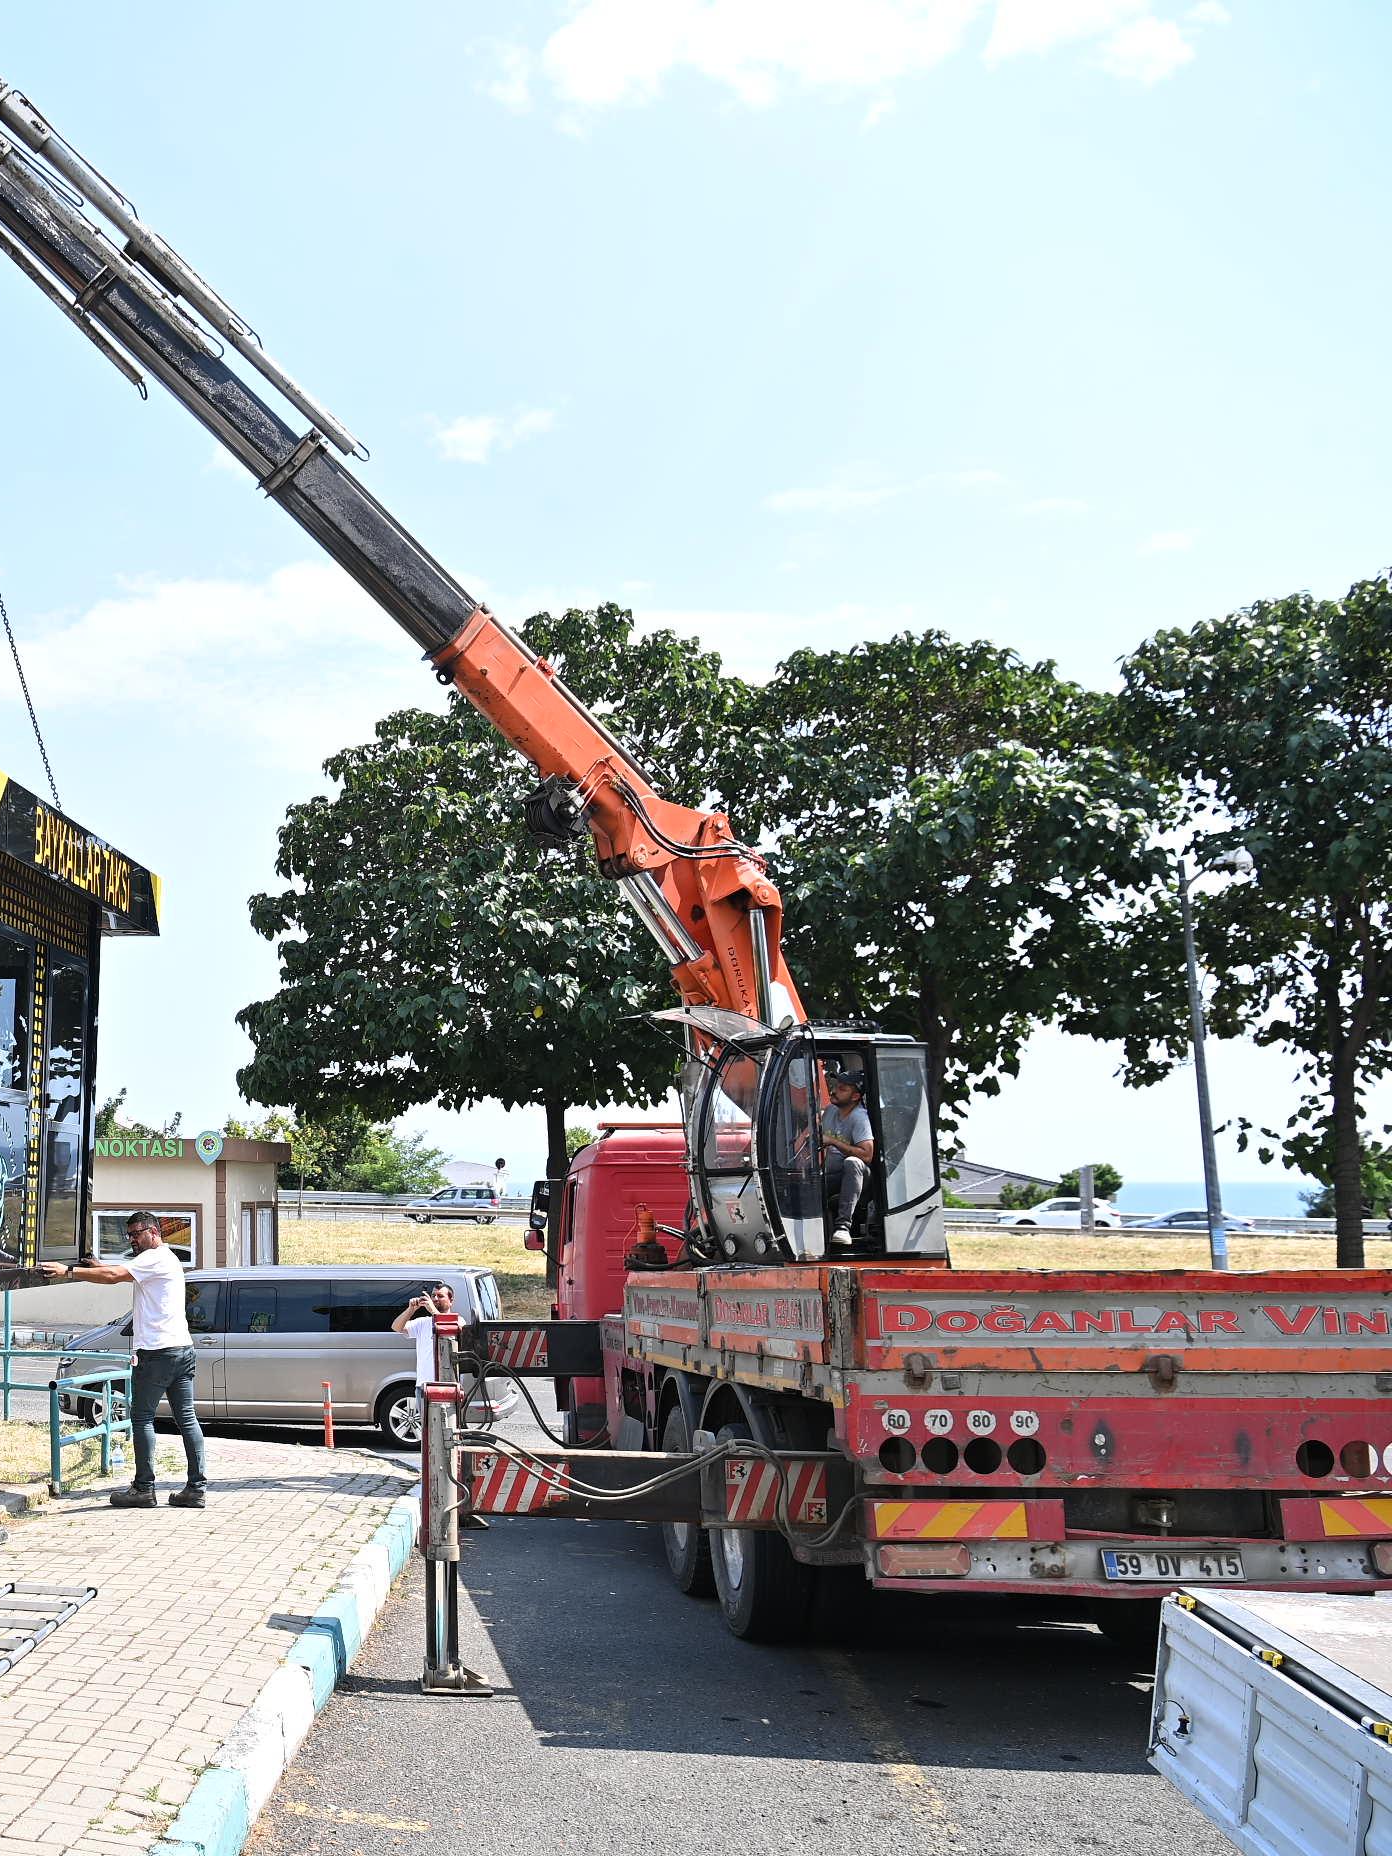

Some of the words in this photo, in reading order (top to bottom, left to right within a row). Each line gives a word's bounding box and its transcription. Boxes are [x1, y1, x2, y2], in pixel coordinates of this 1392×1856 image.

[34, 804, 102, 898] BAYKALLAR
[95, 1139, 184, 1159] NOKTASI
[881, 1304, 1246, 1334] DOĞANLAR
[887, 1414, 906, 1428] 60
[930, 1414, 948, 1428] 70
[972, 1414, 991, 1428] 80
[1015, 1415, 1034, 1429] 90
[1116, 1554, 1142, 1576] 59
[1157, 1554, 1182, 1576] DV
[1199, 1556, 1240, 1576] 415
